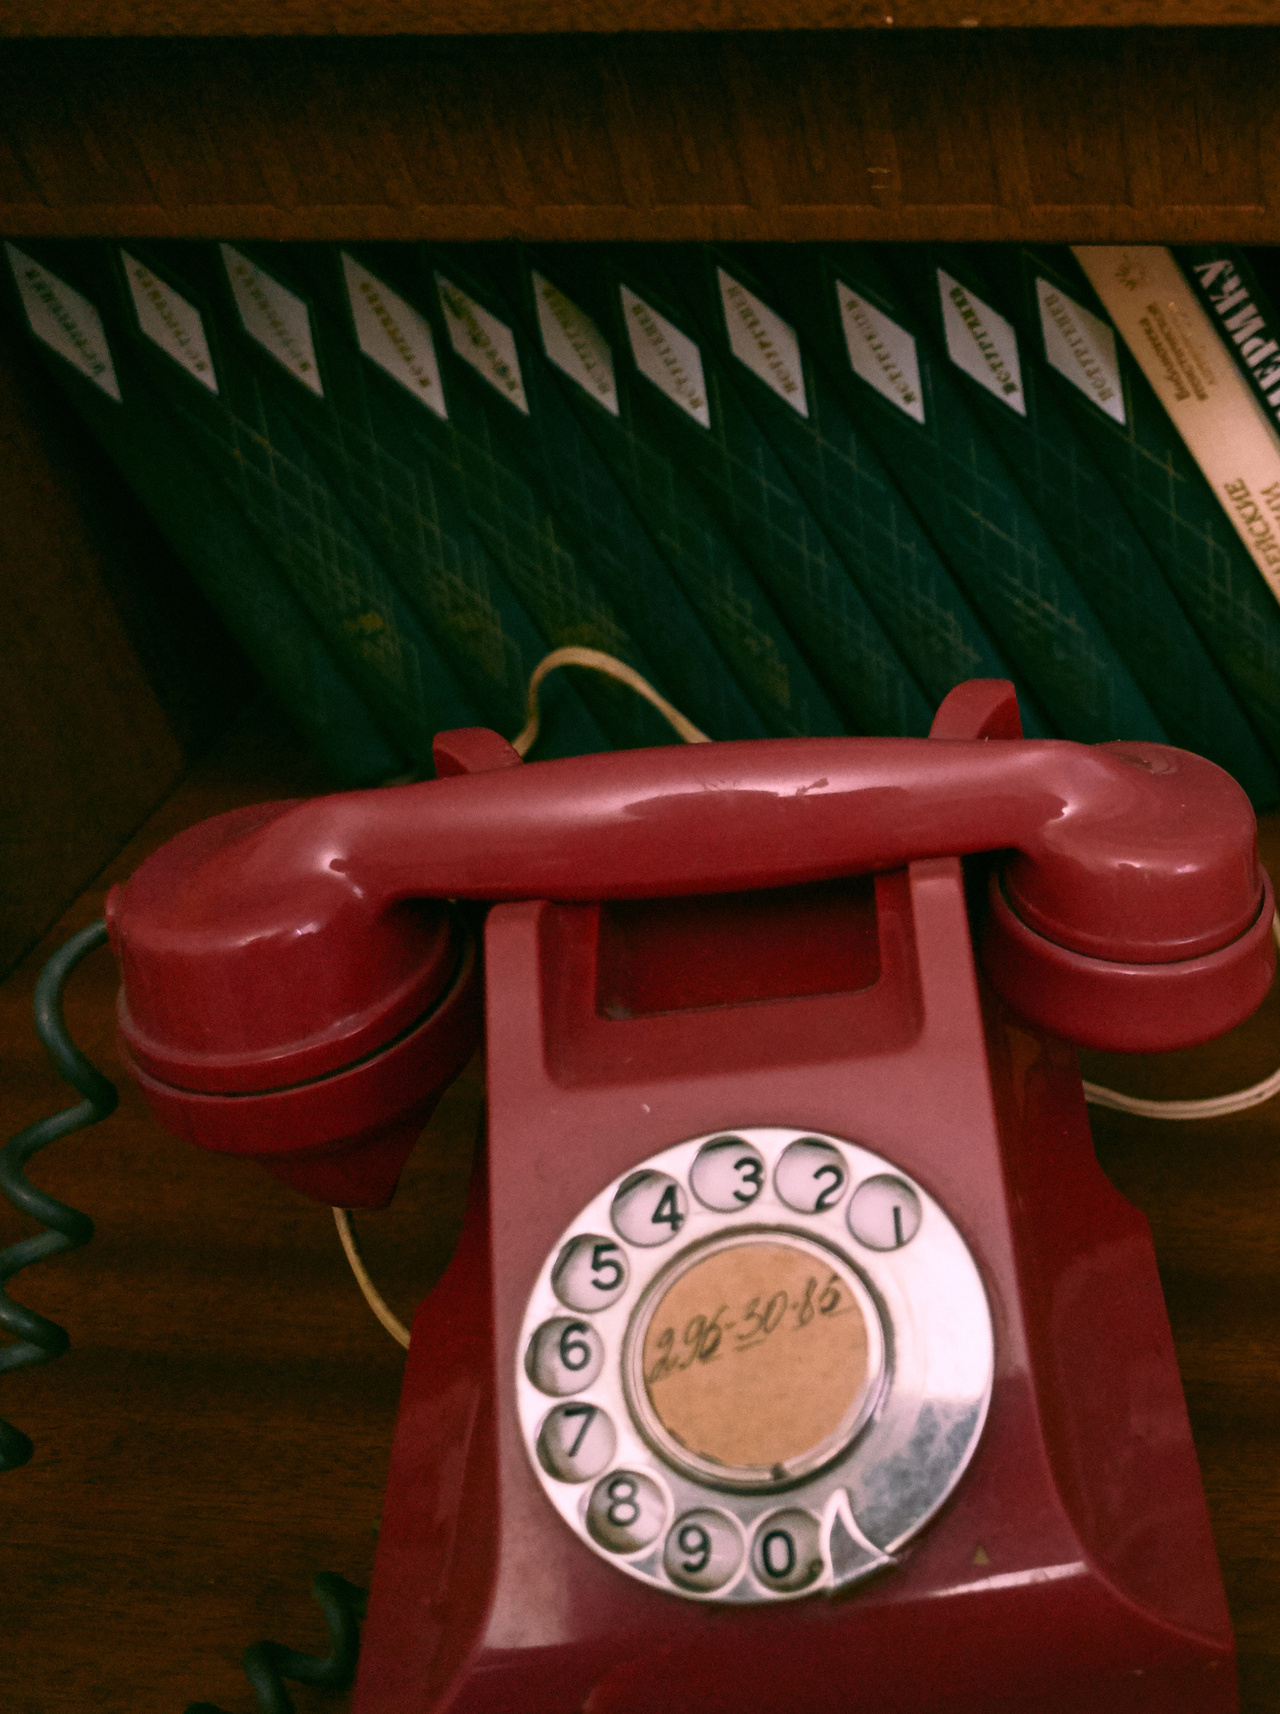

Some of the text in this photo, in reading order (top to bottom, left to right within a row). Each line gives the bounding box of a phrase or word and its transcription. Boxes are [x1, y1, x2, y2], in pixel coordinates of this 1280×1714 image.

[733, 1158, 762, 1202] 3
[813, 1167, 845, 1212] 2
[652, 1186, 683, 1231] 4
[591, 1245, 623, 1290] 5
[560, 1324, 589, 1370] 6
[565, 1407, 598, 1458] 7
[607, 1477, 638, 1527] 8
[679, 1526, 711, 1571] 9
[763, 1531, 795, 1576] 0
